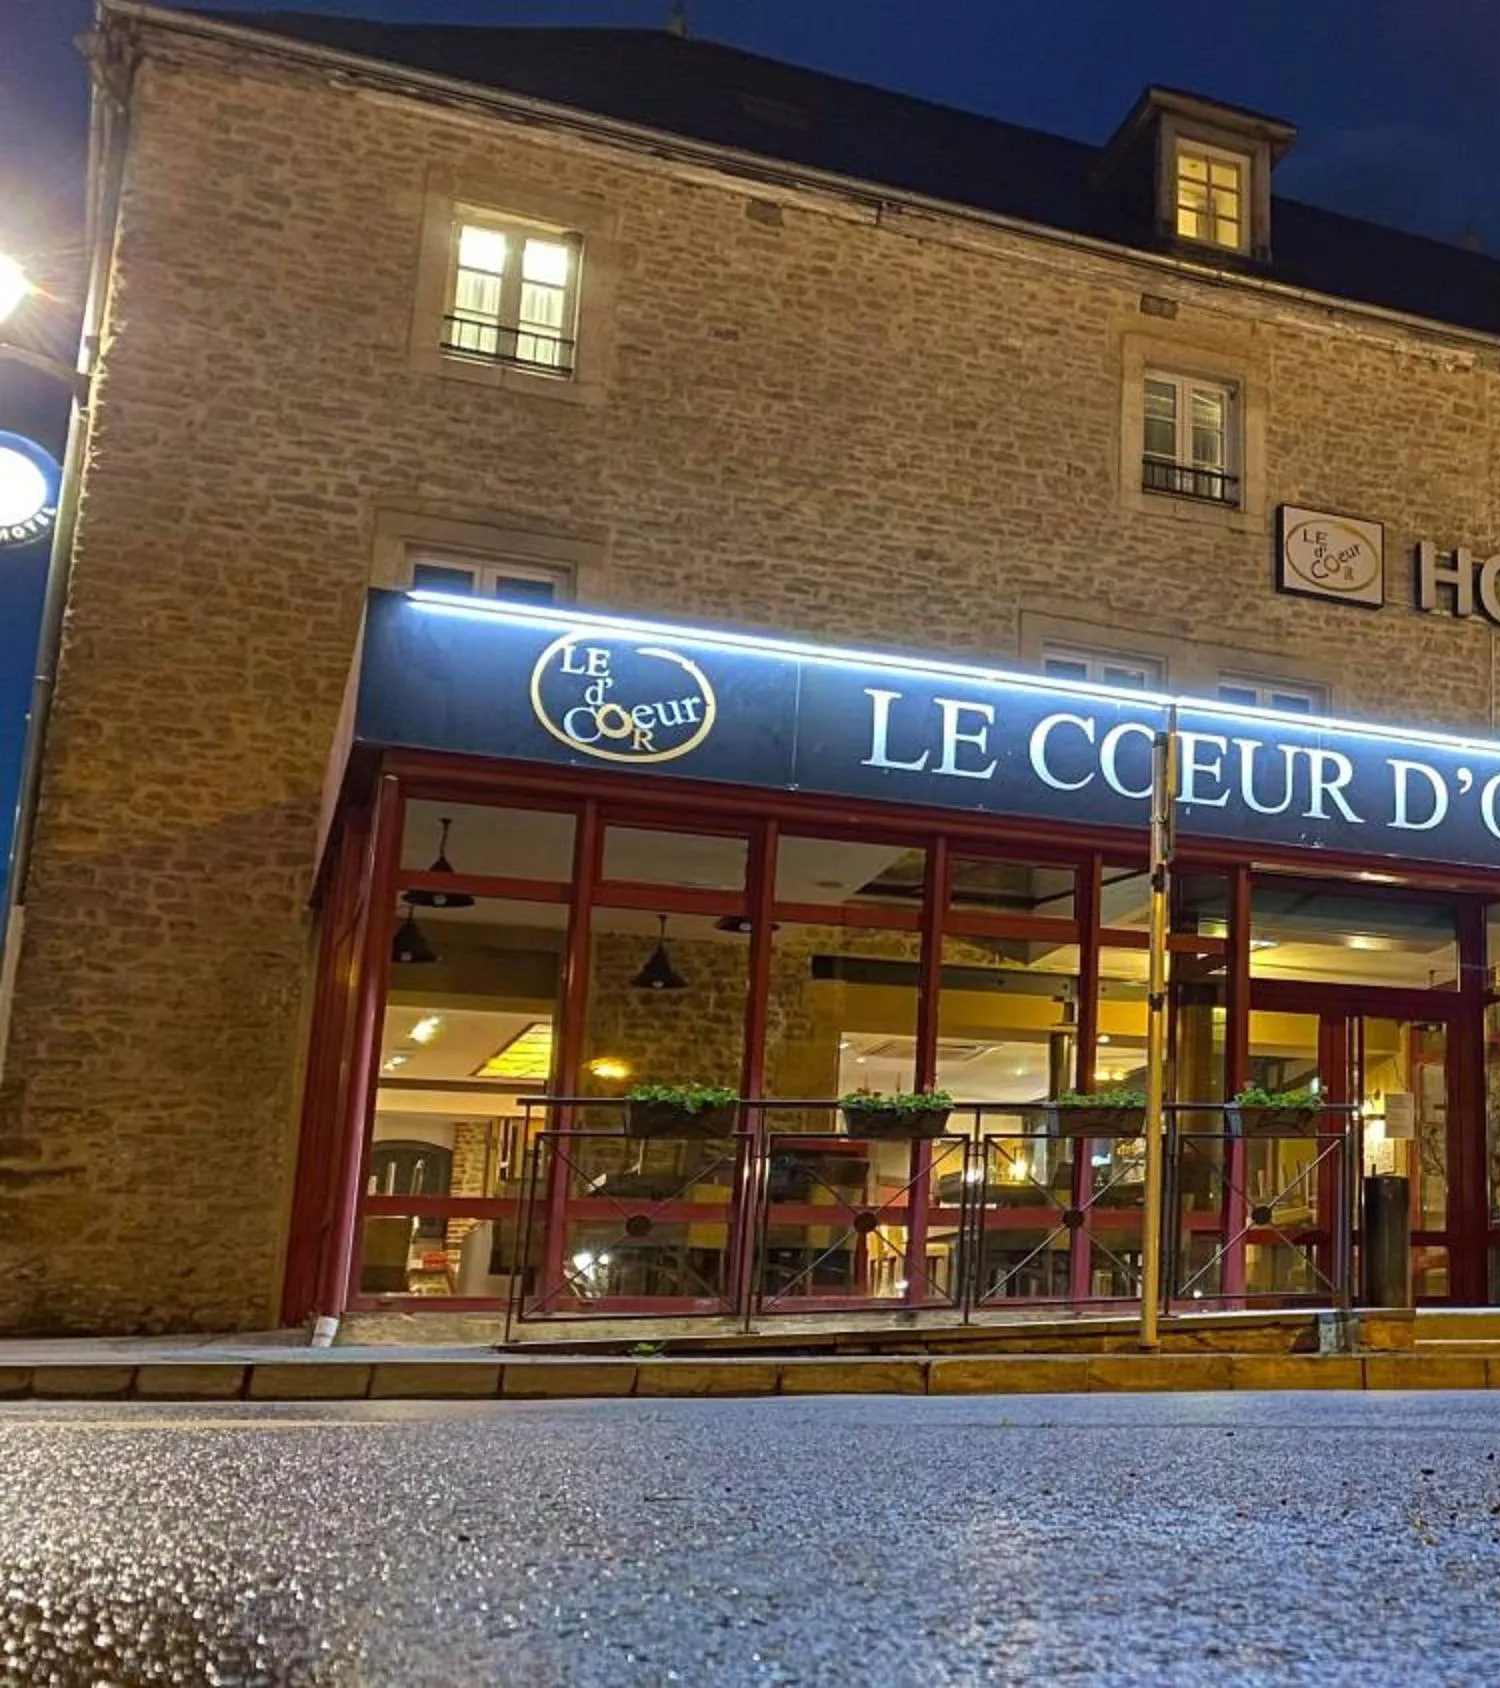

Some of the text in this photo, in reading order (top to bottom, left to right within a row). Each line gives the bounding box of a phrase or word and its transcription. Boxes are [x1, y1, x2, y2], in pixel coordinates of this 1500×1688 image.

[1302, 527, 1328, 545] LE
[560, 645, 612, 677] LE
[860, 687, 998, 780] LE
